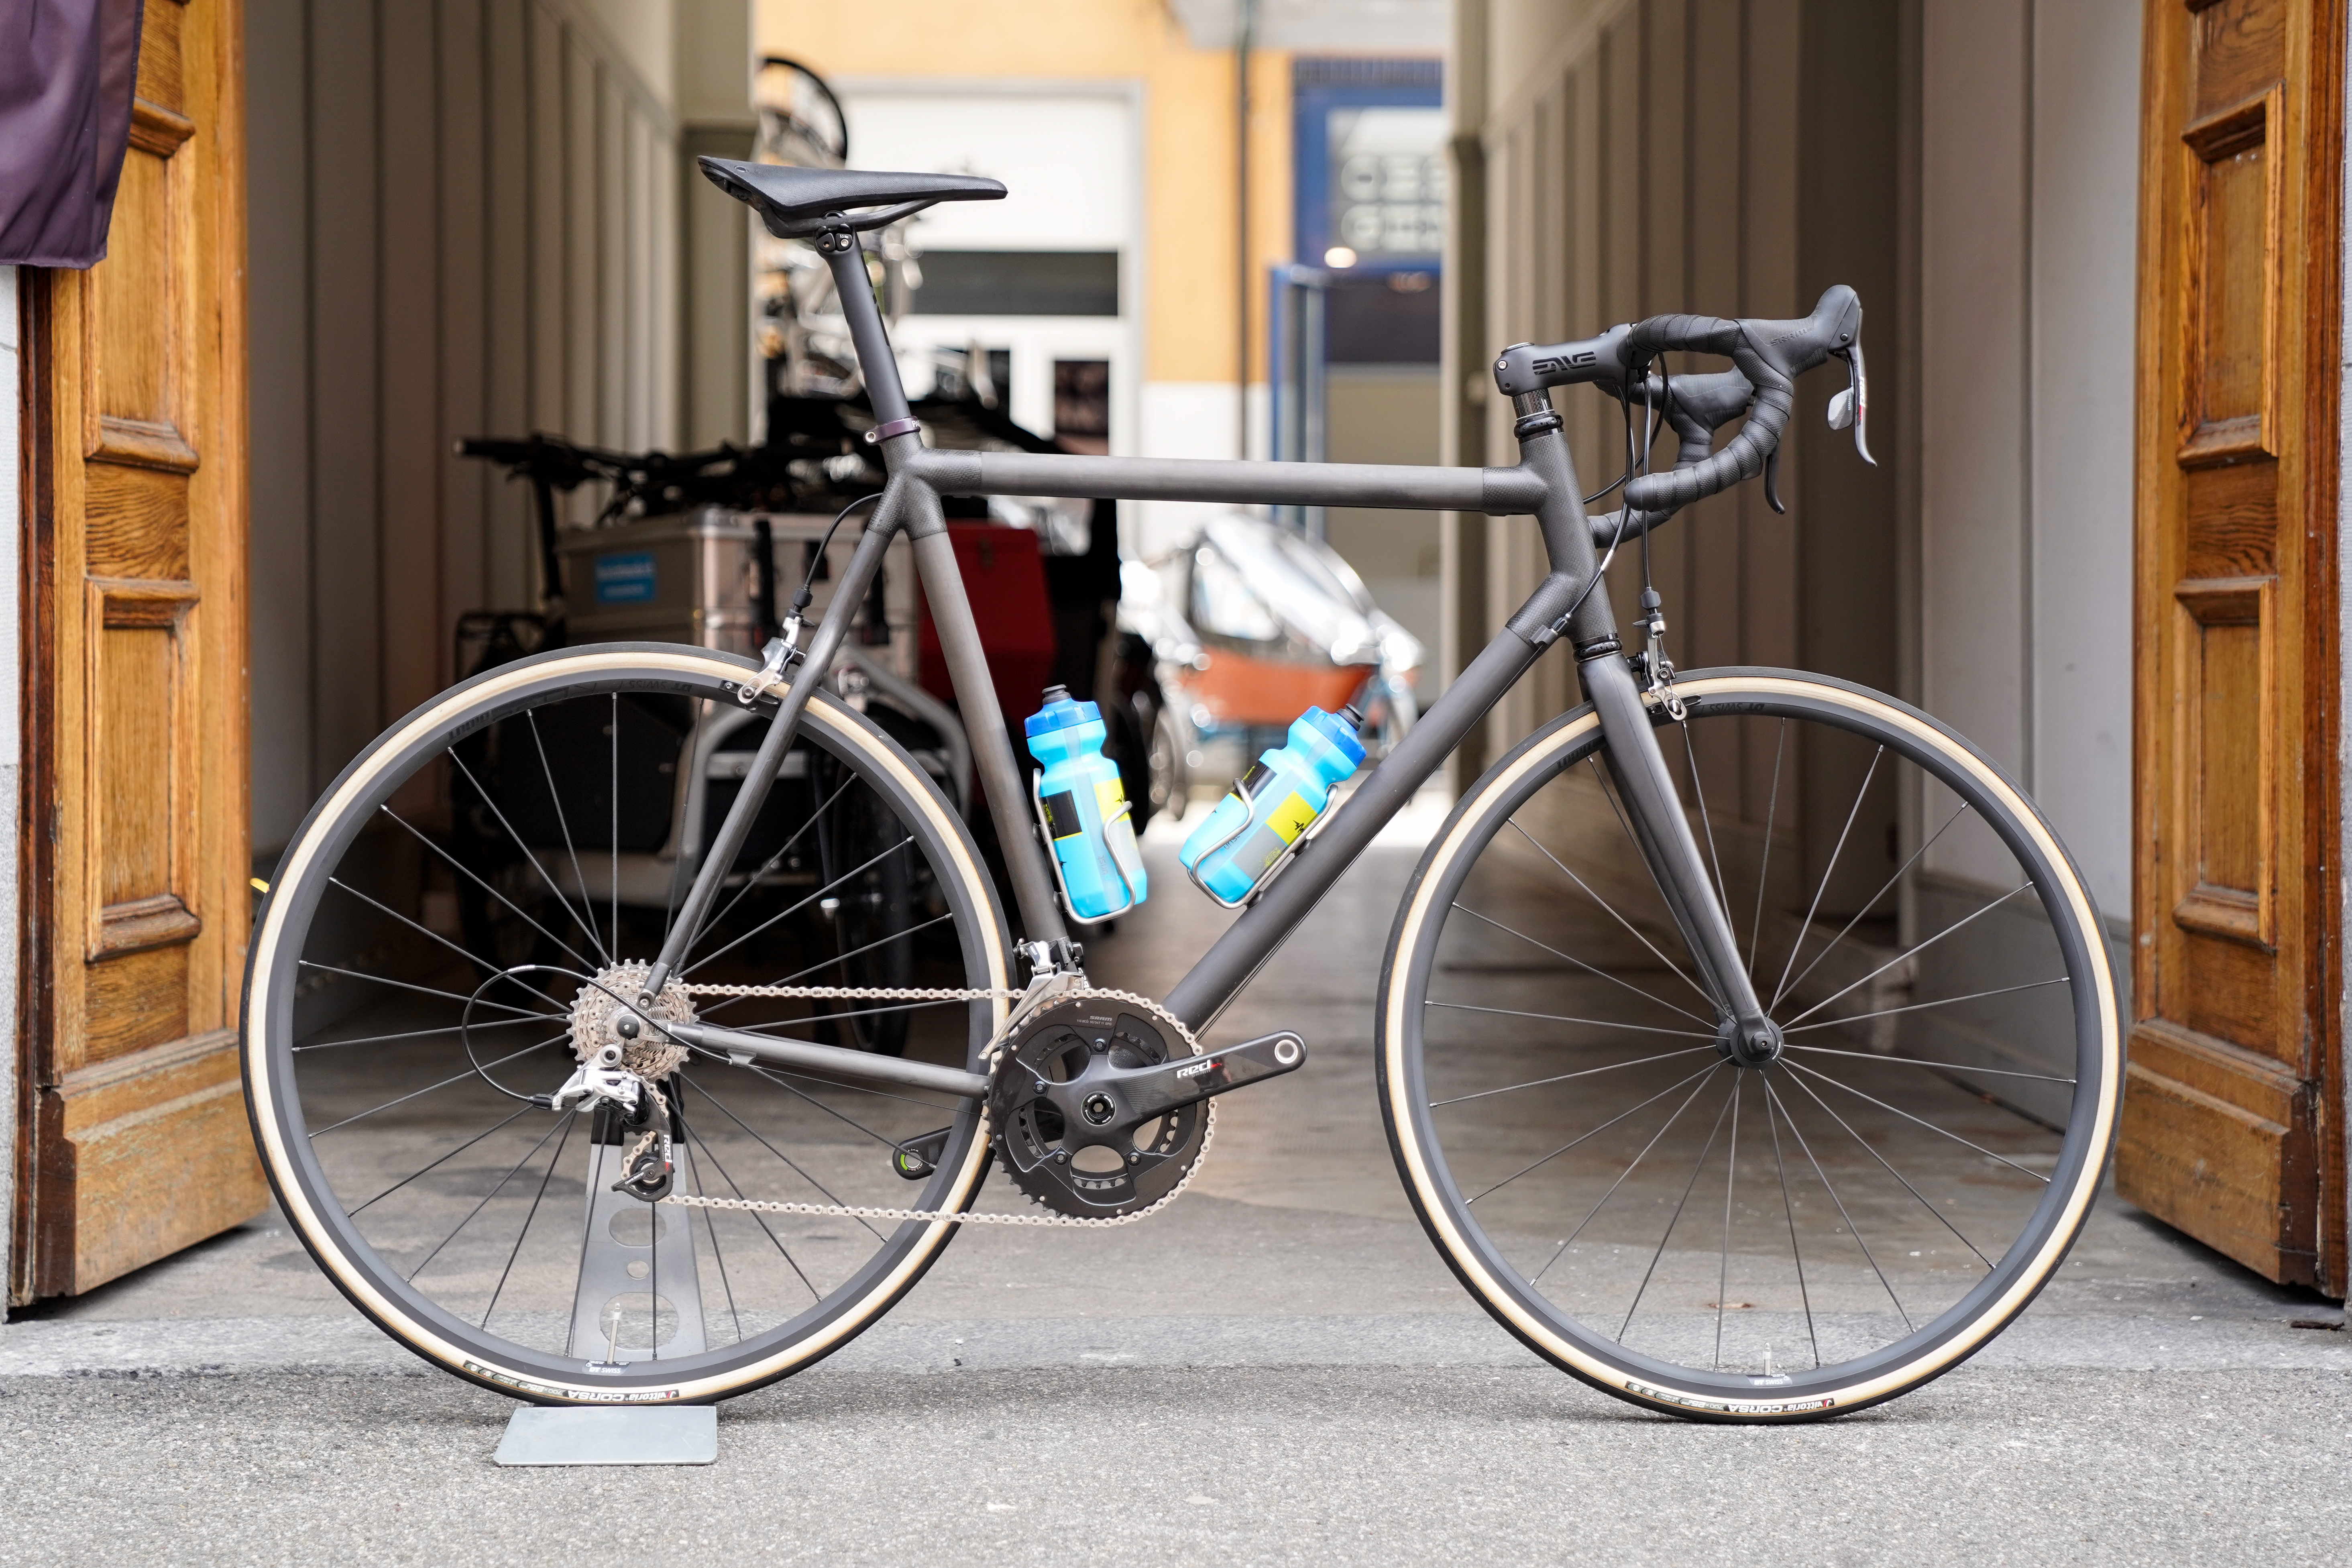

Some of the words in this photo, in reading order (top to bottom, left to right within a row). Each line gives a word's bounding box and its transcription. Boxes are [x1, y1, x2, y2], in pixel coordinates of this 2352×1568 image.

[1710, 703, 1743, 712] SWISS
[1746, 703, 1765, 711] DT
[568, 1390, 625, 1401] CORSA
[1728, 1404, 1783, 1413] CORSA
